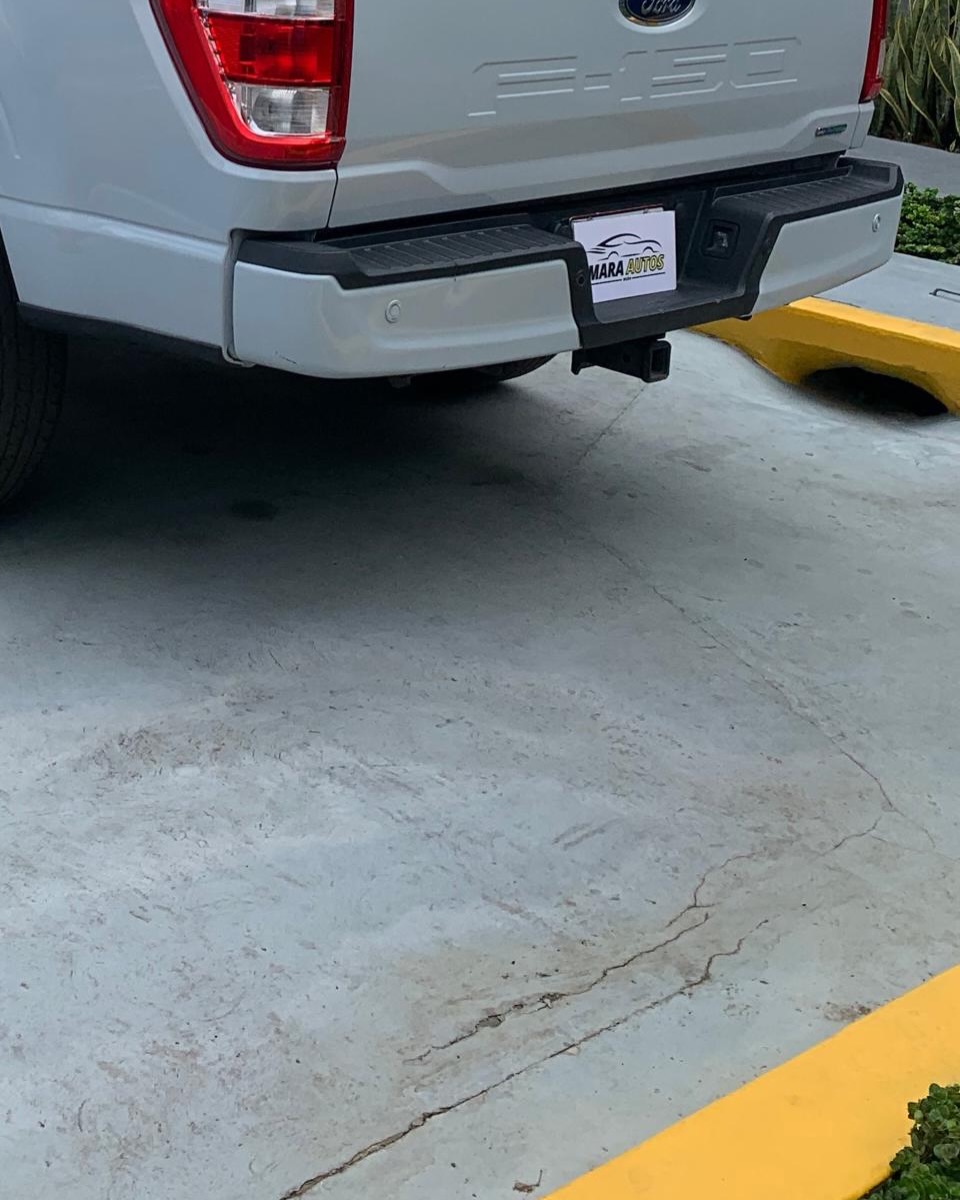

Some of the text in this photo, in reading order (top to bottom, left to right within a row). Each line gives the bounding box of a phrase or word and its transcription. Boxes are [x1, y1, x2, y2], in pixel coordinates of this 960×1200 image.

[468, 36, 803, 117] F-150
[590, 253, 665, 281] MARA AUTOS
